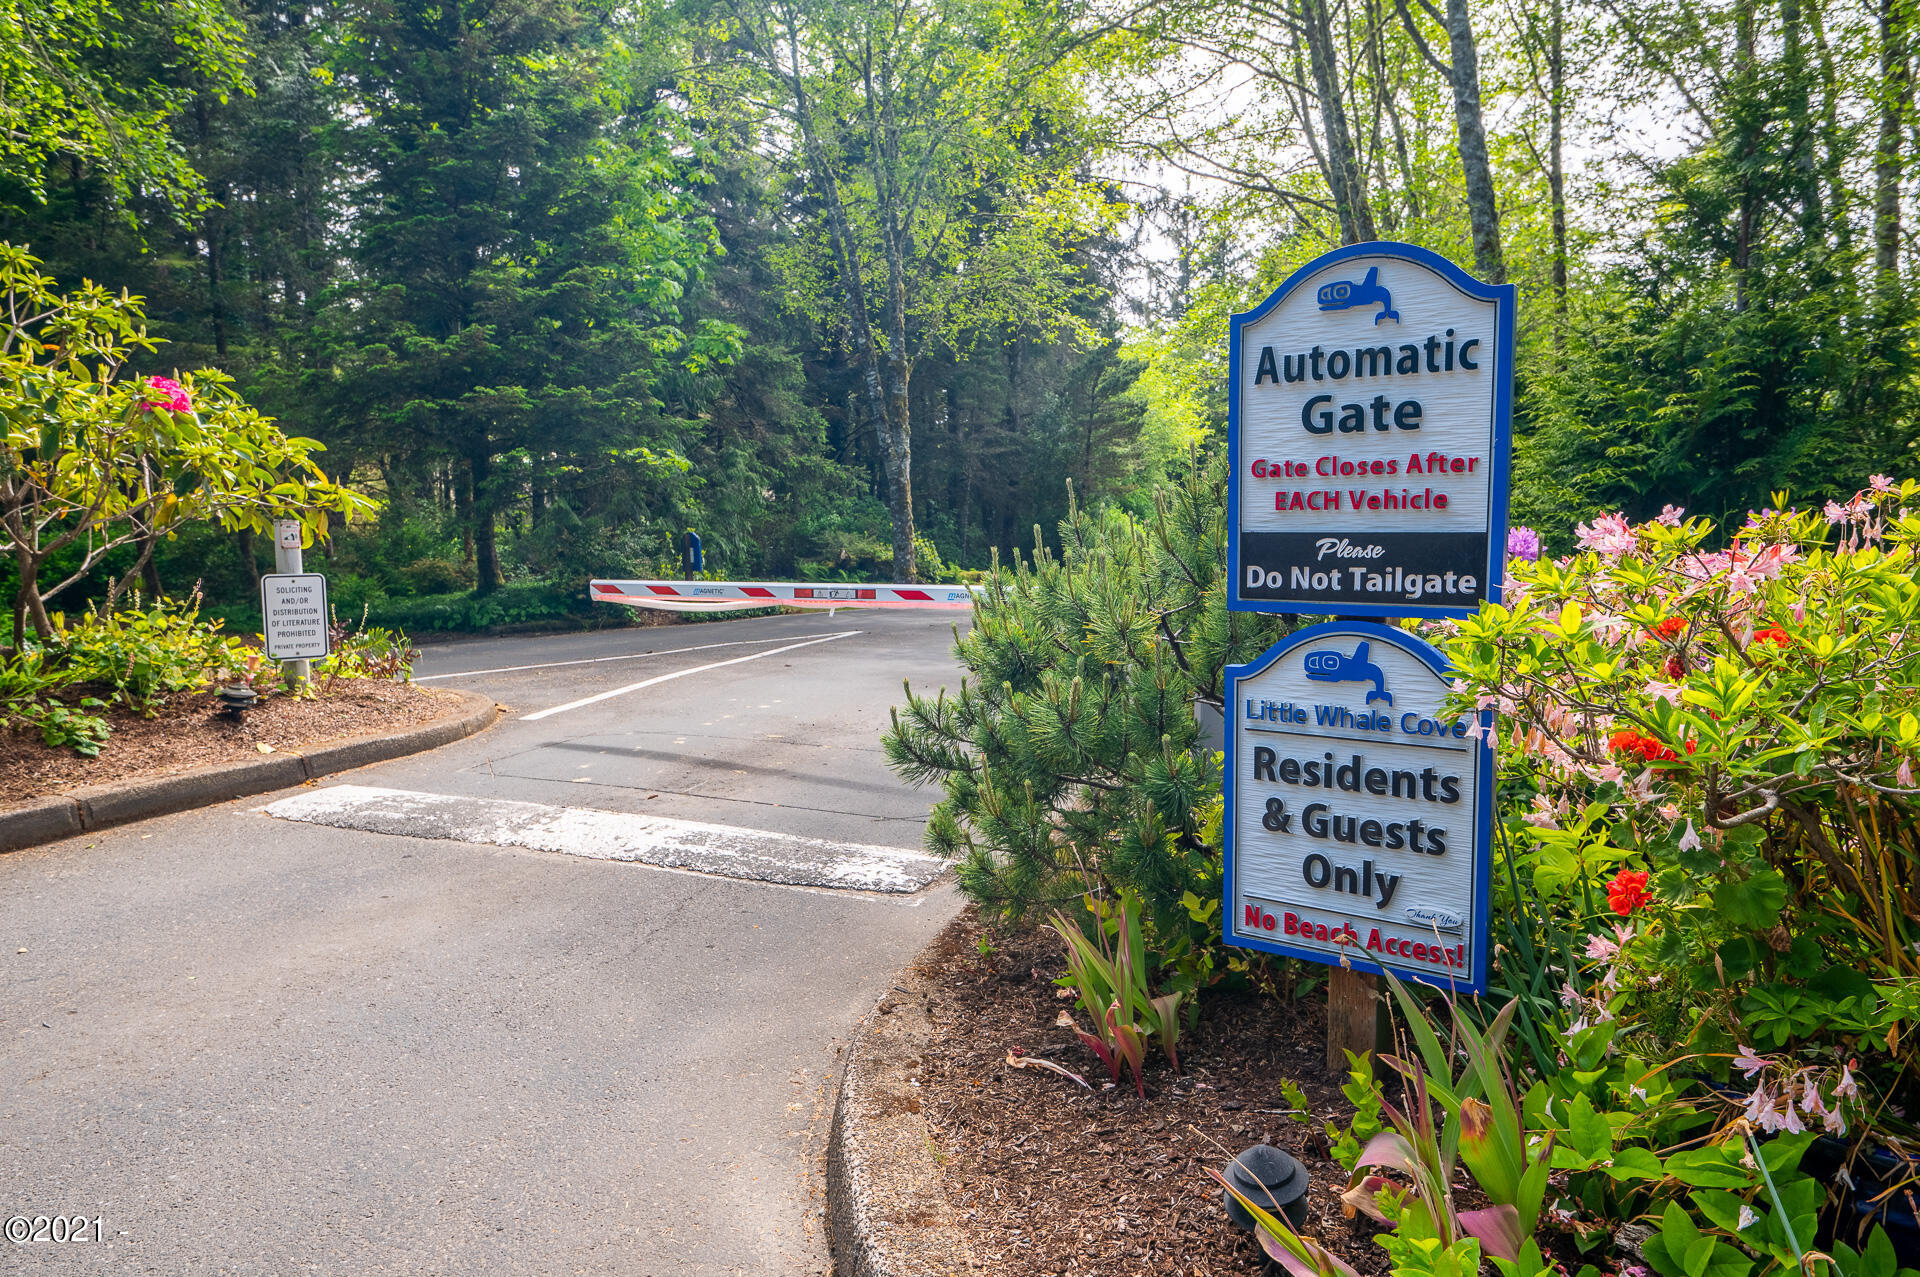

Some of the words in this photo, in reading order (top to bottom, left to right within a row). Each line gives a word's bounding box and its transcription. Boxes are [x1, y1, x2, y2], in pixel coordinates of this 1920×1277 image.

[1254, 328, 1480, 386] Automatic
[1301, 394, 1423, 435] Gate
[1251, 459, 1308, 479] Gate
[1315, 456, 1398, 477] Closes
[1406, 452, 1479, 474] After
[1275, 490, 1340, 511] EACH
[1349, 488, 1448, 510] Vehicle
[1315, 538, 1385, 560] Please
[1246, 566, 1282, 589] Do
[1291, 566, 1342, 591] Not
[1349, 567, 1477, 599] Tailgate
[1246, 699, 1307, 725] Little
[1315, 705, 1392, 732] Whale
[1401, 712, 1467, 738] Cove
[1254, 746, 1461, 804] Residents
[1262, 797, 1292, 834] &
[1301, 803, 1447, 856] Guests
[1303, 853, 1401, 910] Only
[1245, 904, 1276, 931] No
[1284, 912, 1358, 947] Beach
[1366, 928, 1464, 968] Access!
[1407, 908, 1436, 921] Thank
[1439, 914, 1458, 927] You
